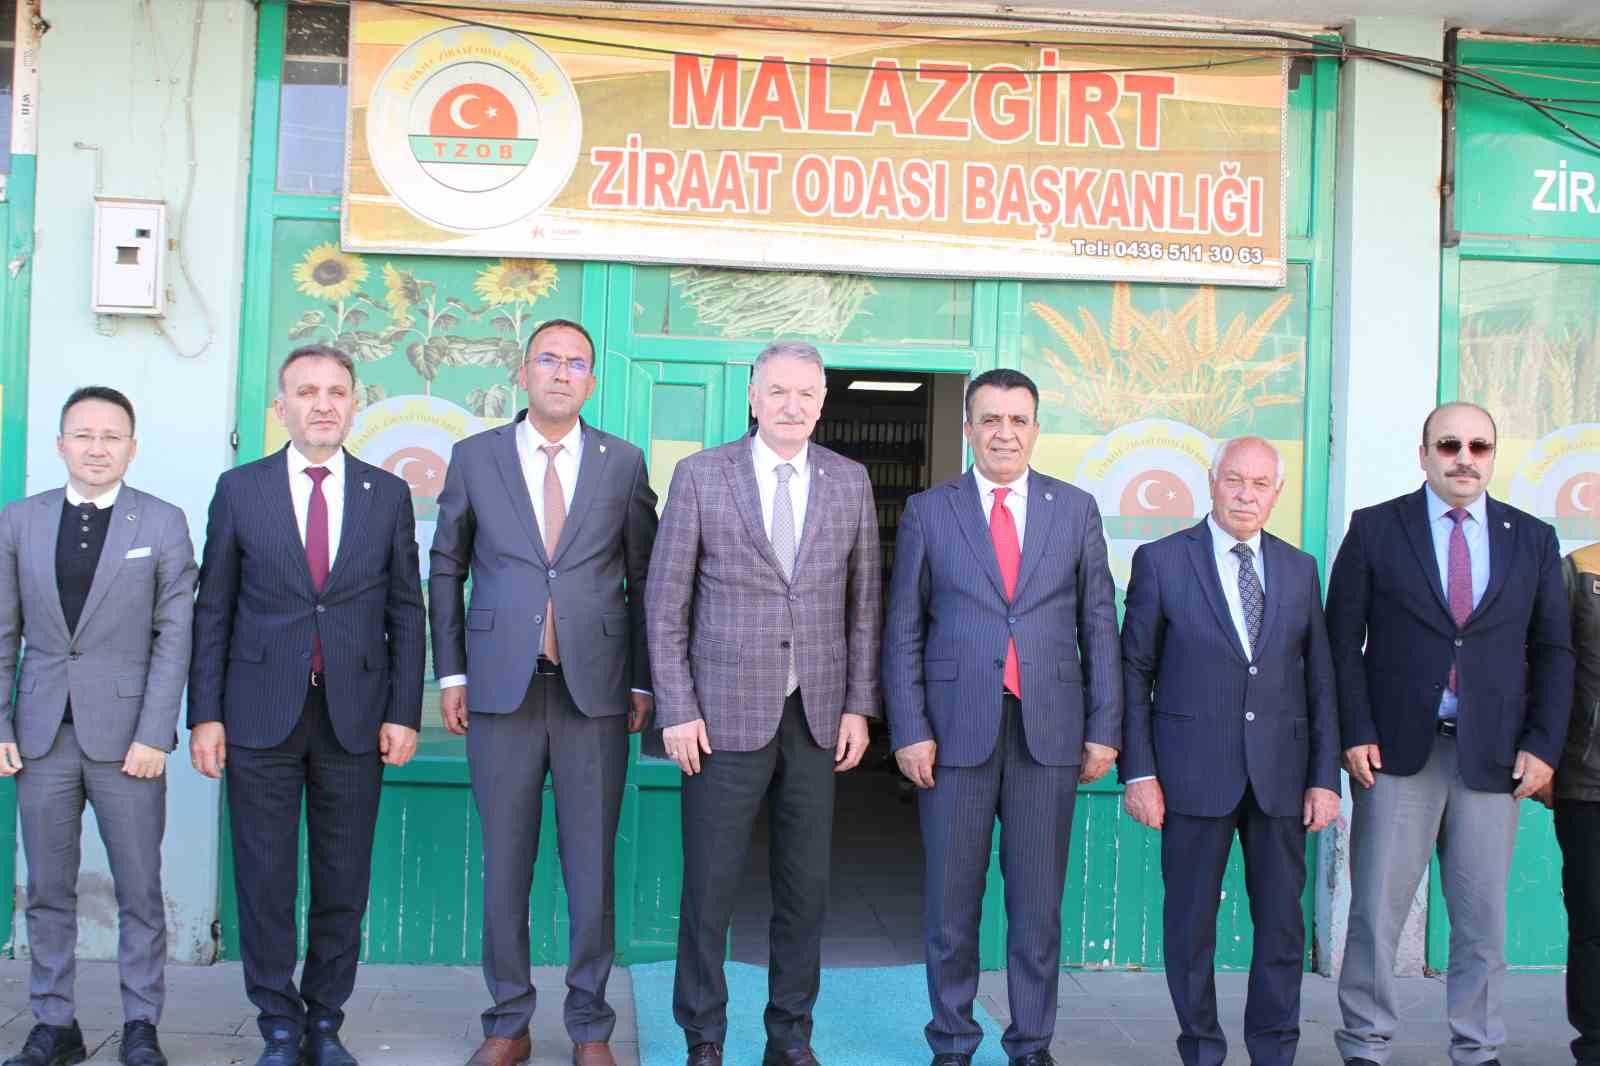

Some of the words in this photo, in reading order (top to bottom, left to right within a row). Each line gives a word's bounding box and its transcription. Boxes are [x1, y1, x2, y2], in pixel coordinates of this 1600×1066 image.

[669, 48, 1176, 151] MALAZGİRT
[432, 142, 513, 160] TZOB
[588, 133, 782, 214] ZİRAAT
[792, 153, 949, 222] ODASI
[962, 161, 1264, 241] BAŞKANLIĞI
[1531, 159, 1600, 213] ZİR
[1072, 239, 1109, 257] Tel:
[1114, 241, 1164, 259] 0436
[1168, 243, 1204, 262] 511
[1208, 245, 1234, 262] 30
[1238, 247, 1264, 264] 63
